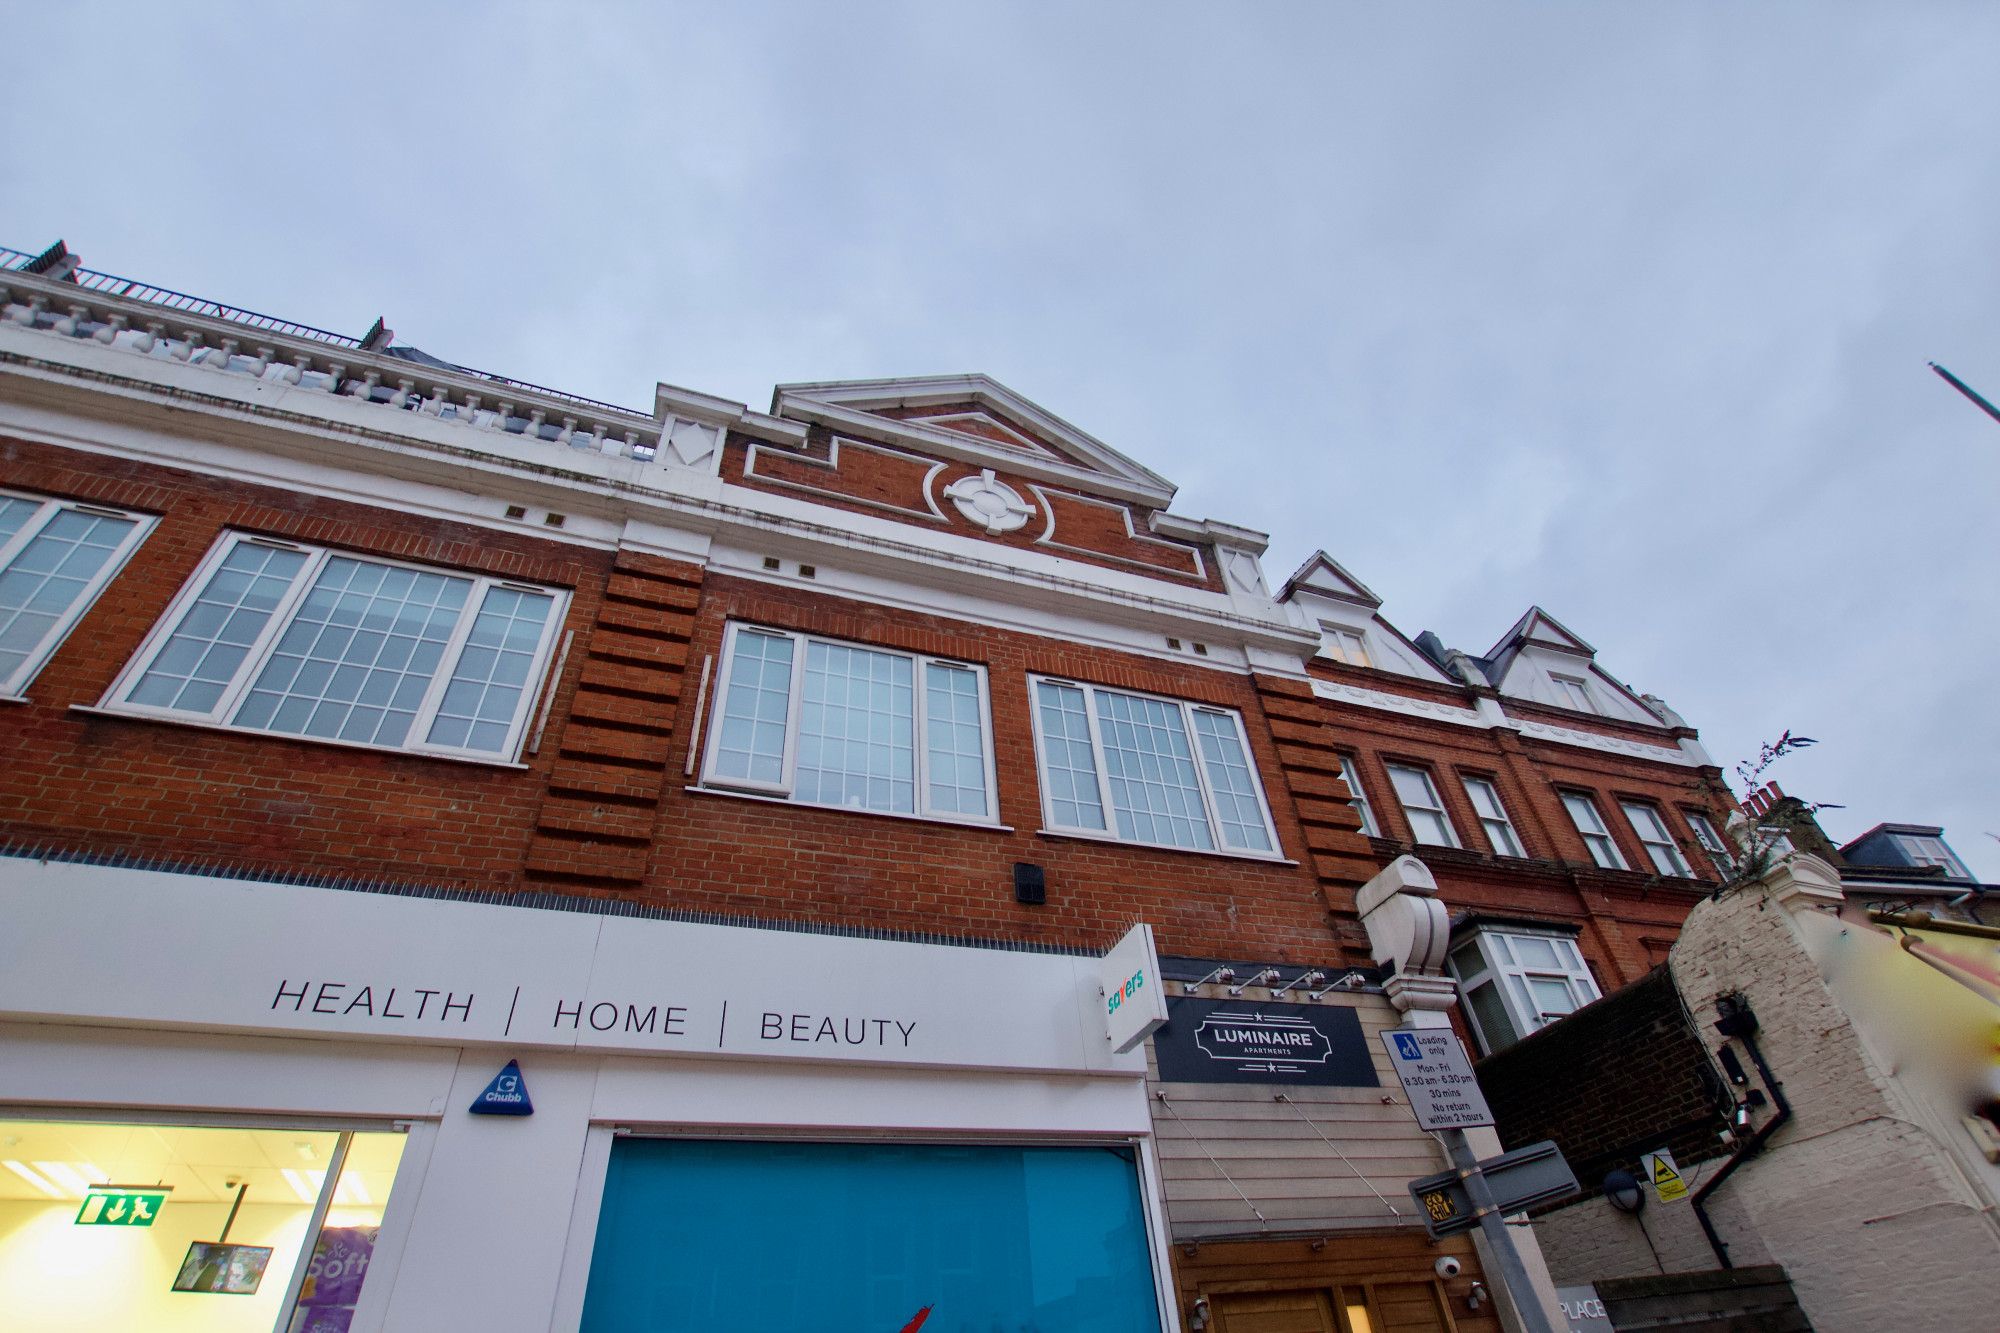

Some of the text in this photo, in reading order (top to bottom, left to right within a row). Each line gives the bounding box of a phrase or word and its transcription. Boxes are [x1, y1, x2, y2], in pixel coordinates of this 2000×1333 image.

[1108, 969, 1143, 1015] savers
[271, 979, 916, 1047] HEALTH HOME BEAUTY
[1214, 1029, 1313, 1046] LUMINAIRE
[1416, 1035, 1448, 1045] Loading
[1244, 1047, 1291, 1055] APARTMENTS
[1428, 1046, 1445, 1056] only
[1404, 1076, 1424, 1086] 8.30
[485, 1091, 522, 1103] Chubb
[1429, 1088, 1462, 1099] 30 mins
[1431, 1102, 1471, 1112] No return
[1428, 1114, 1454, 1124] within
[1460, 1113, 1484, 1122] hours
[309, 1251, 369, 1279] Soft
